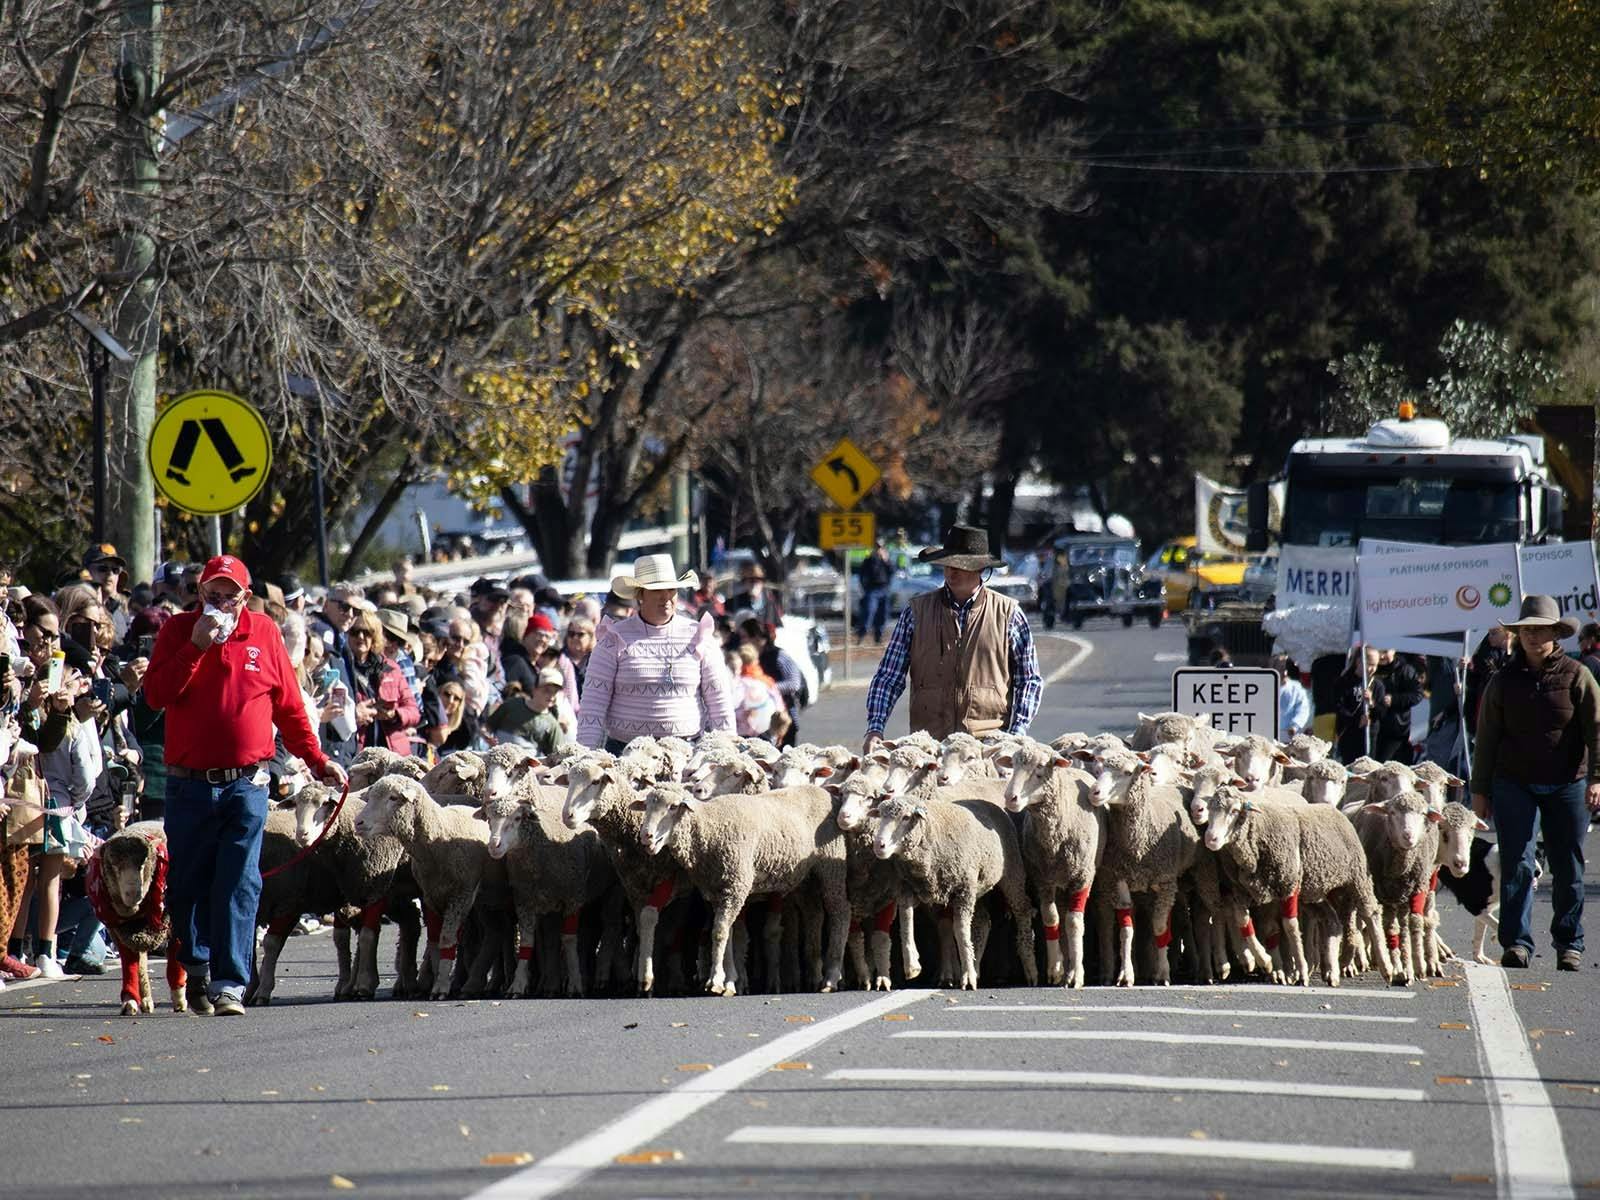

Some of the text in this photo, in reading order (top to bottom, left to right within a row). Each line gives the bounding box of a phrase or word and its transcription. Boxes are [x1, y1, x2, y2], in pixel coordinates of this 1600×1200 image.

[832, 518, 863, 537] 55
[1521, 549, 1573, 561] SPONSOR
[1389, 559, 1489, 576] PLATINUM SPONSOR
[1286, 567, 1358, 597] MERRI
[1366, 592, 1449, 613] lightsourcebp
[1193, 683, 1259, 704] KEEP
[1195, 712, 1256, 733] EFT
